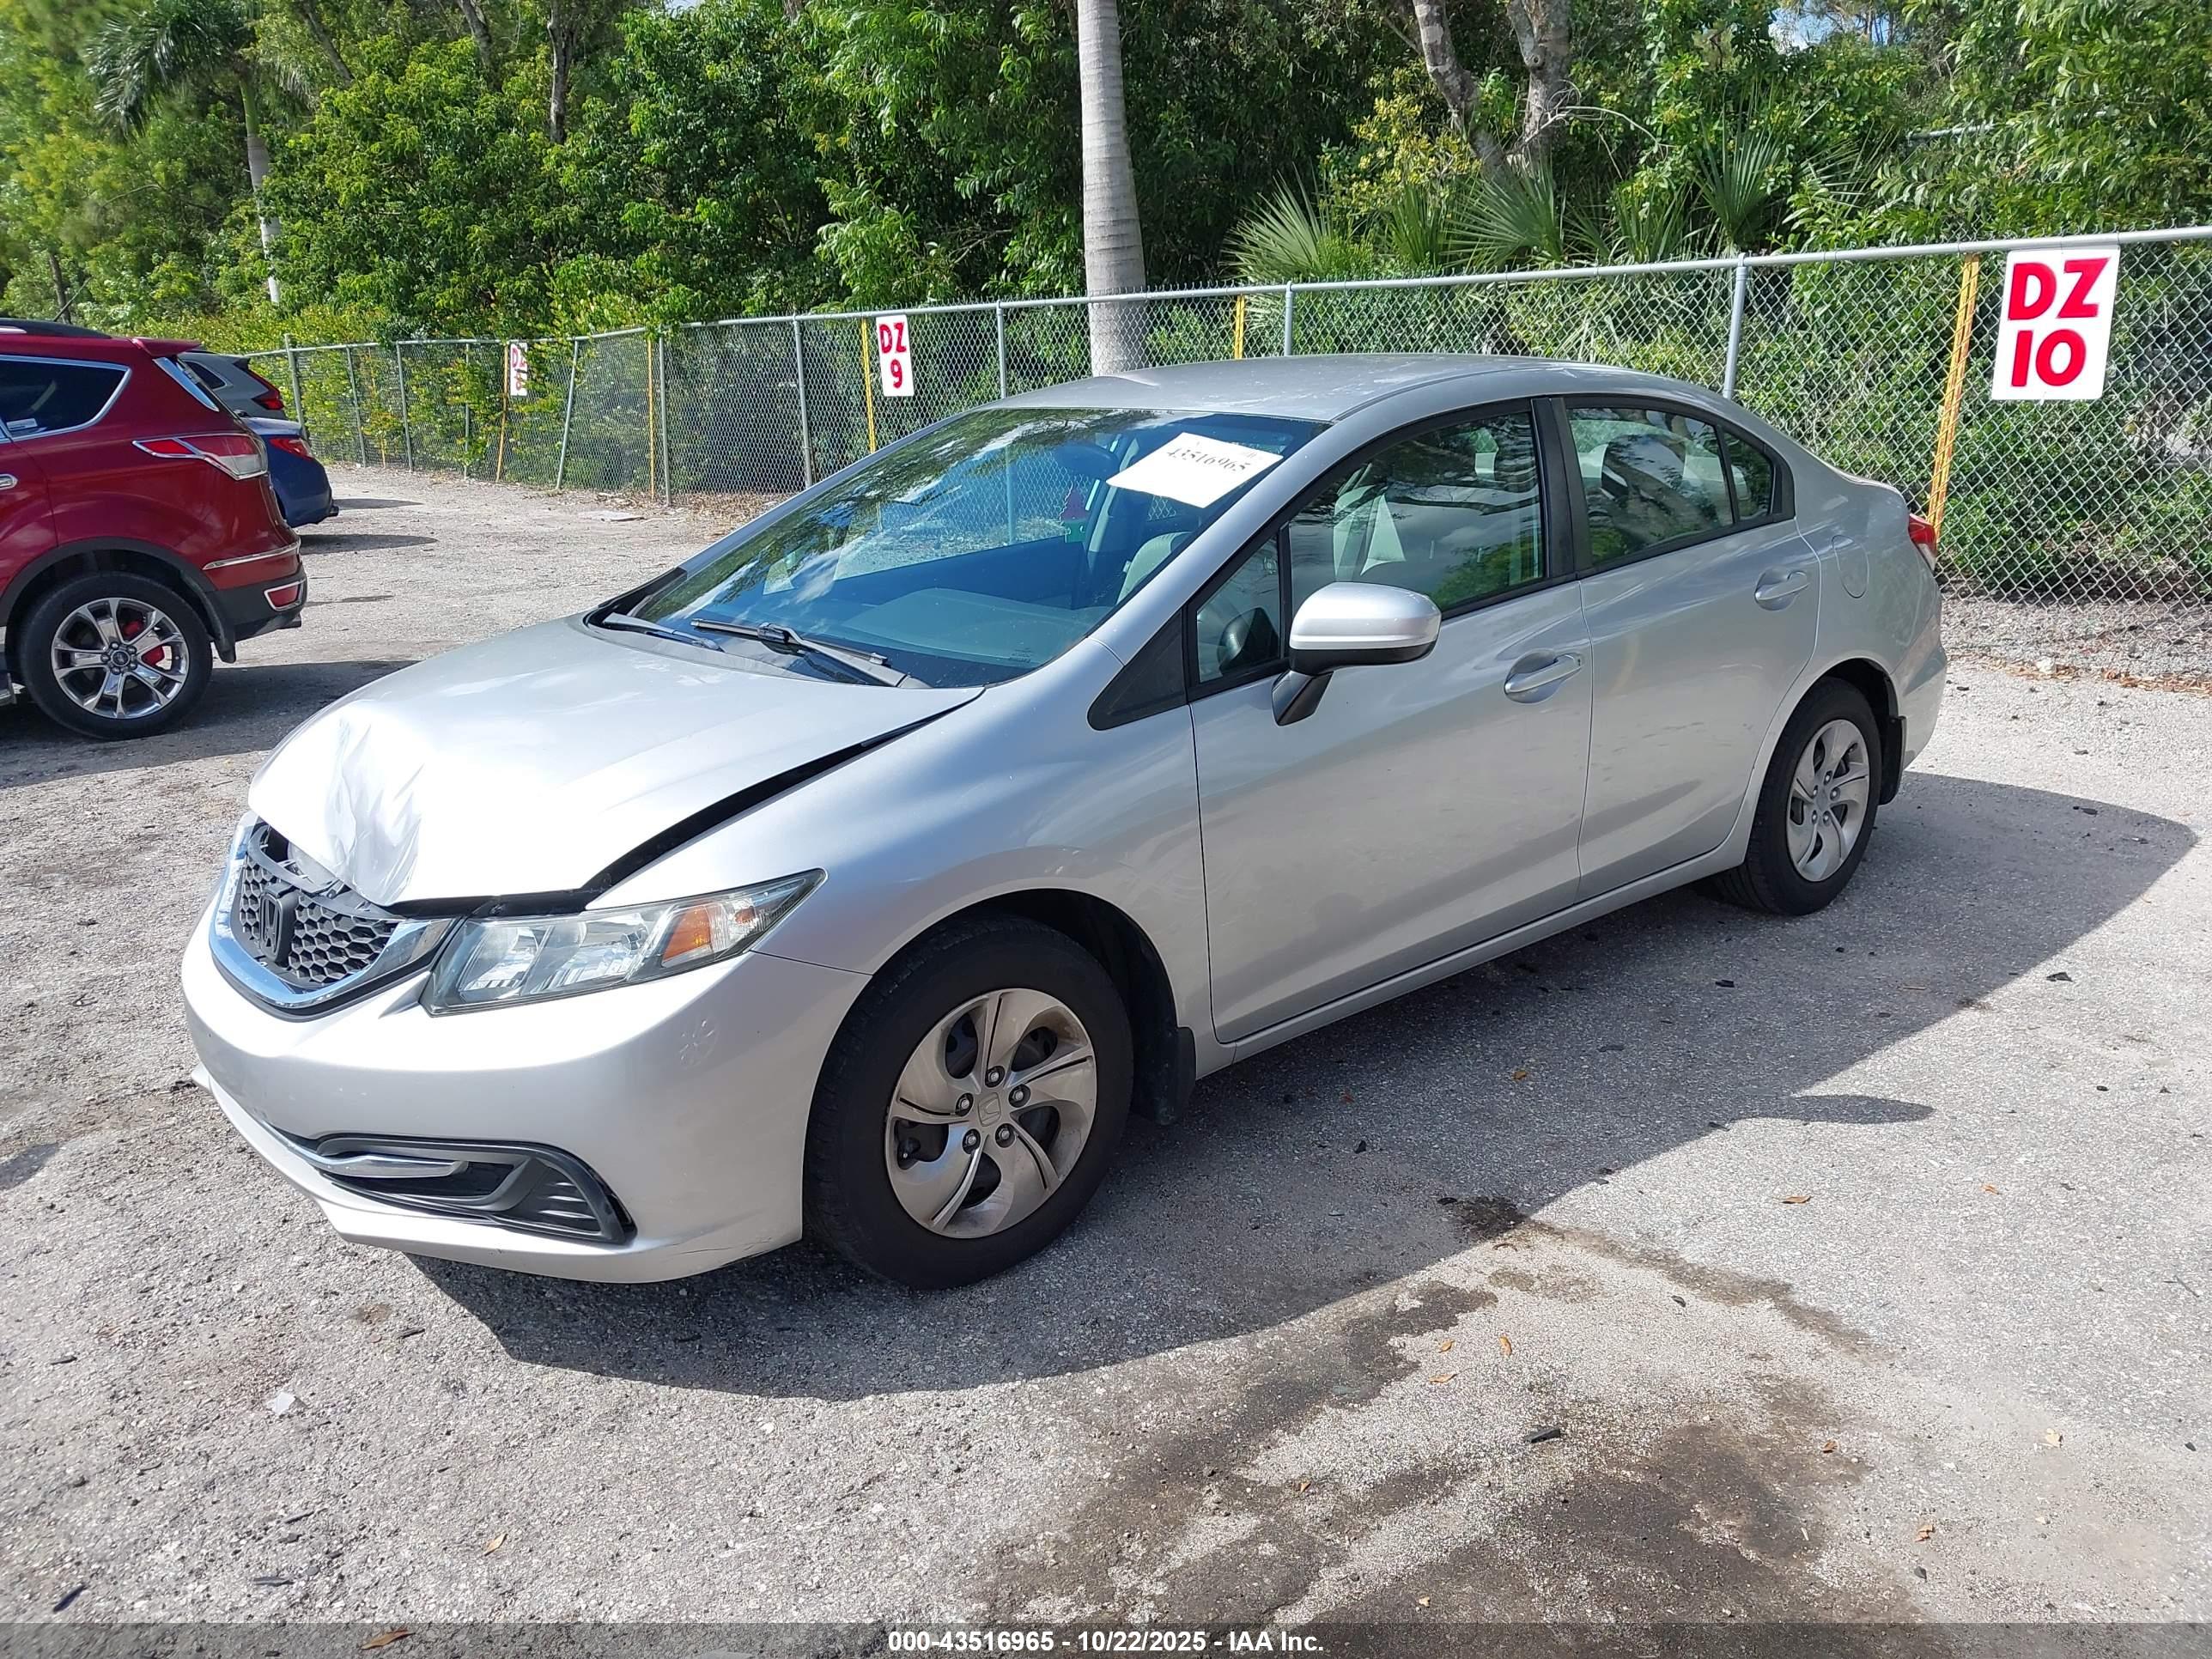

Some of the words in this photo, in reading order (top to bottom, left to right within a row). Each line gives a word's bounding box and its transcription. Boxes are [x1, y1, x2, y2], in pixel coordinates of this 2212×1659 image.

[2008, 258, 2111, 320] DZ
[879, 322, 907, 353] DZ
[890, 358, 903, 388] 9
